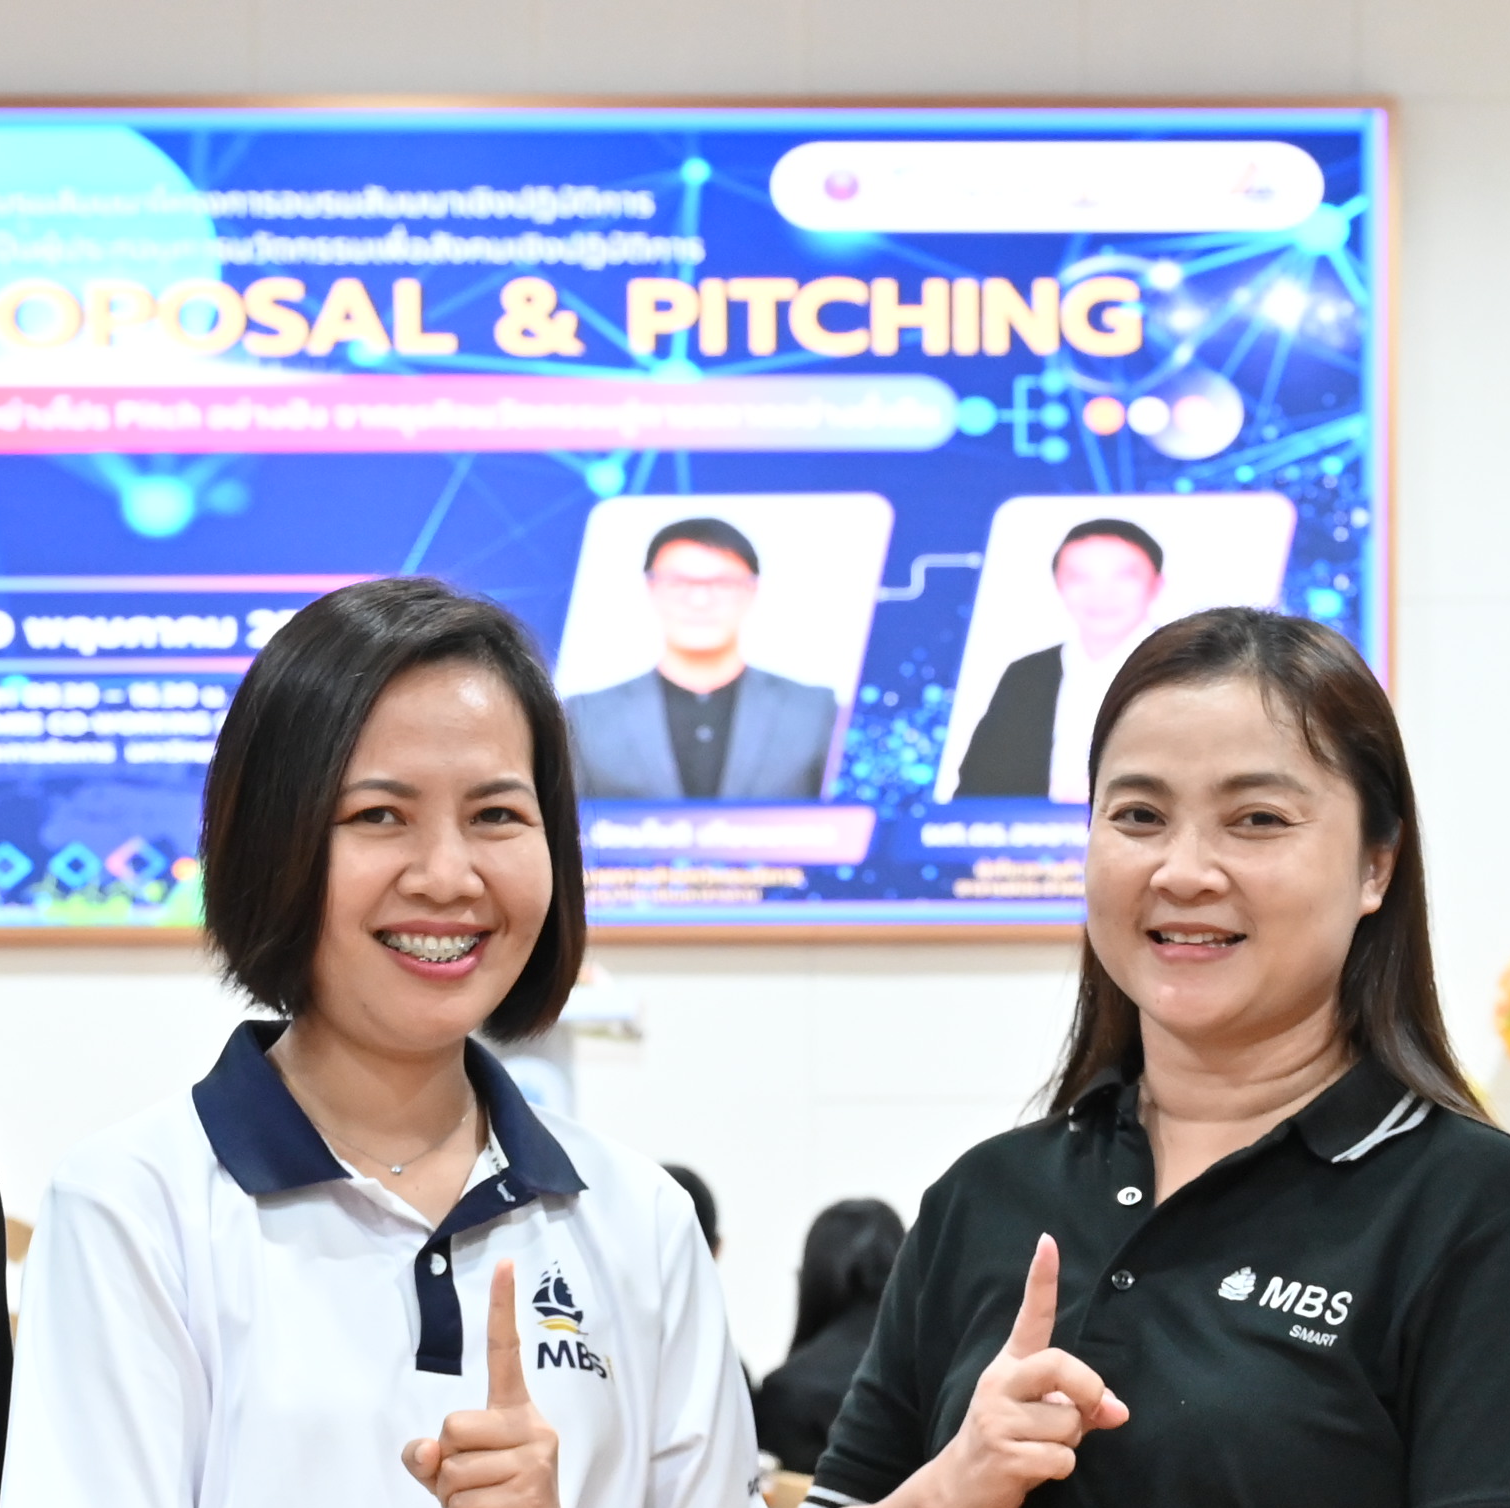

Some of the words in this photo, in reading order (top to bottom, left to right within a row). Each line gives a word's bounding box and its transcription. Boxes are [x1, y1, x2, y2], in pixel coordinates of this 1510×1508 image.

[494, 277, 584, 356] &
[627, 276, 1143, 356] PITCHING
[21, 615, 238, 656] พฤษภาคม
[1259, 1276, 1353, 1325] MBS
[1289, 1324, 1338, 1347] SMART
[537, 1340, 607, 1379] MBS
